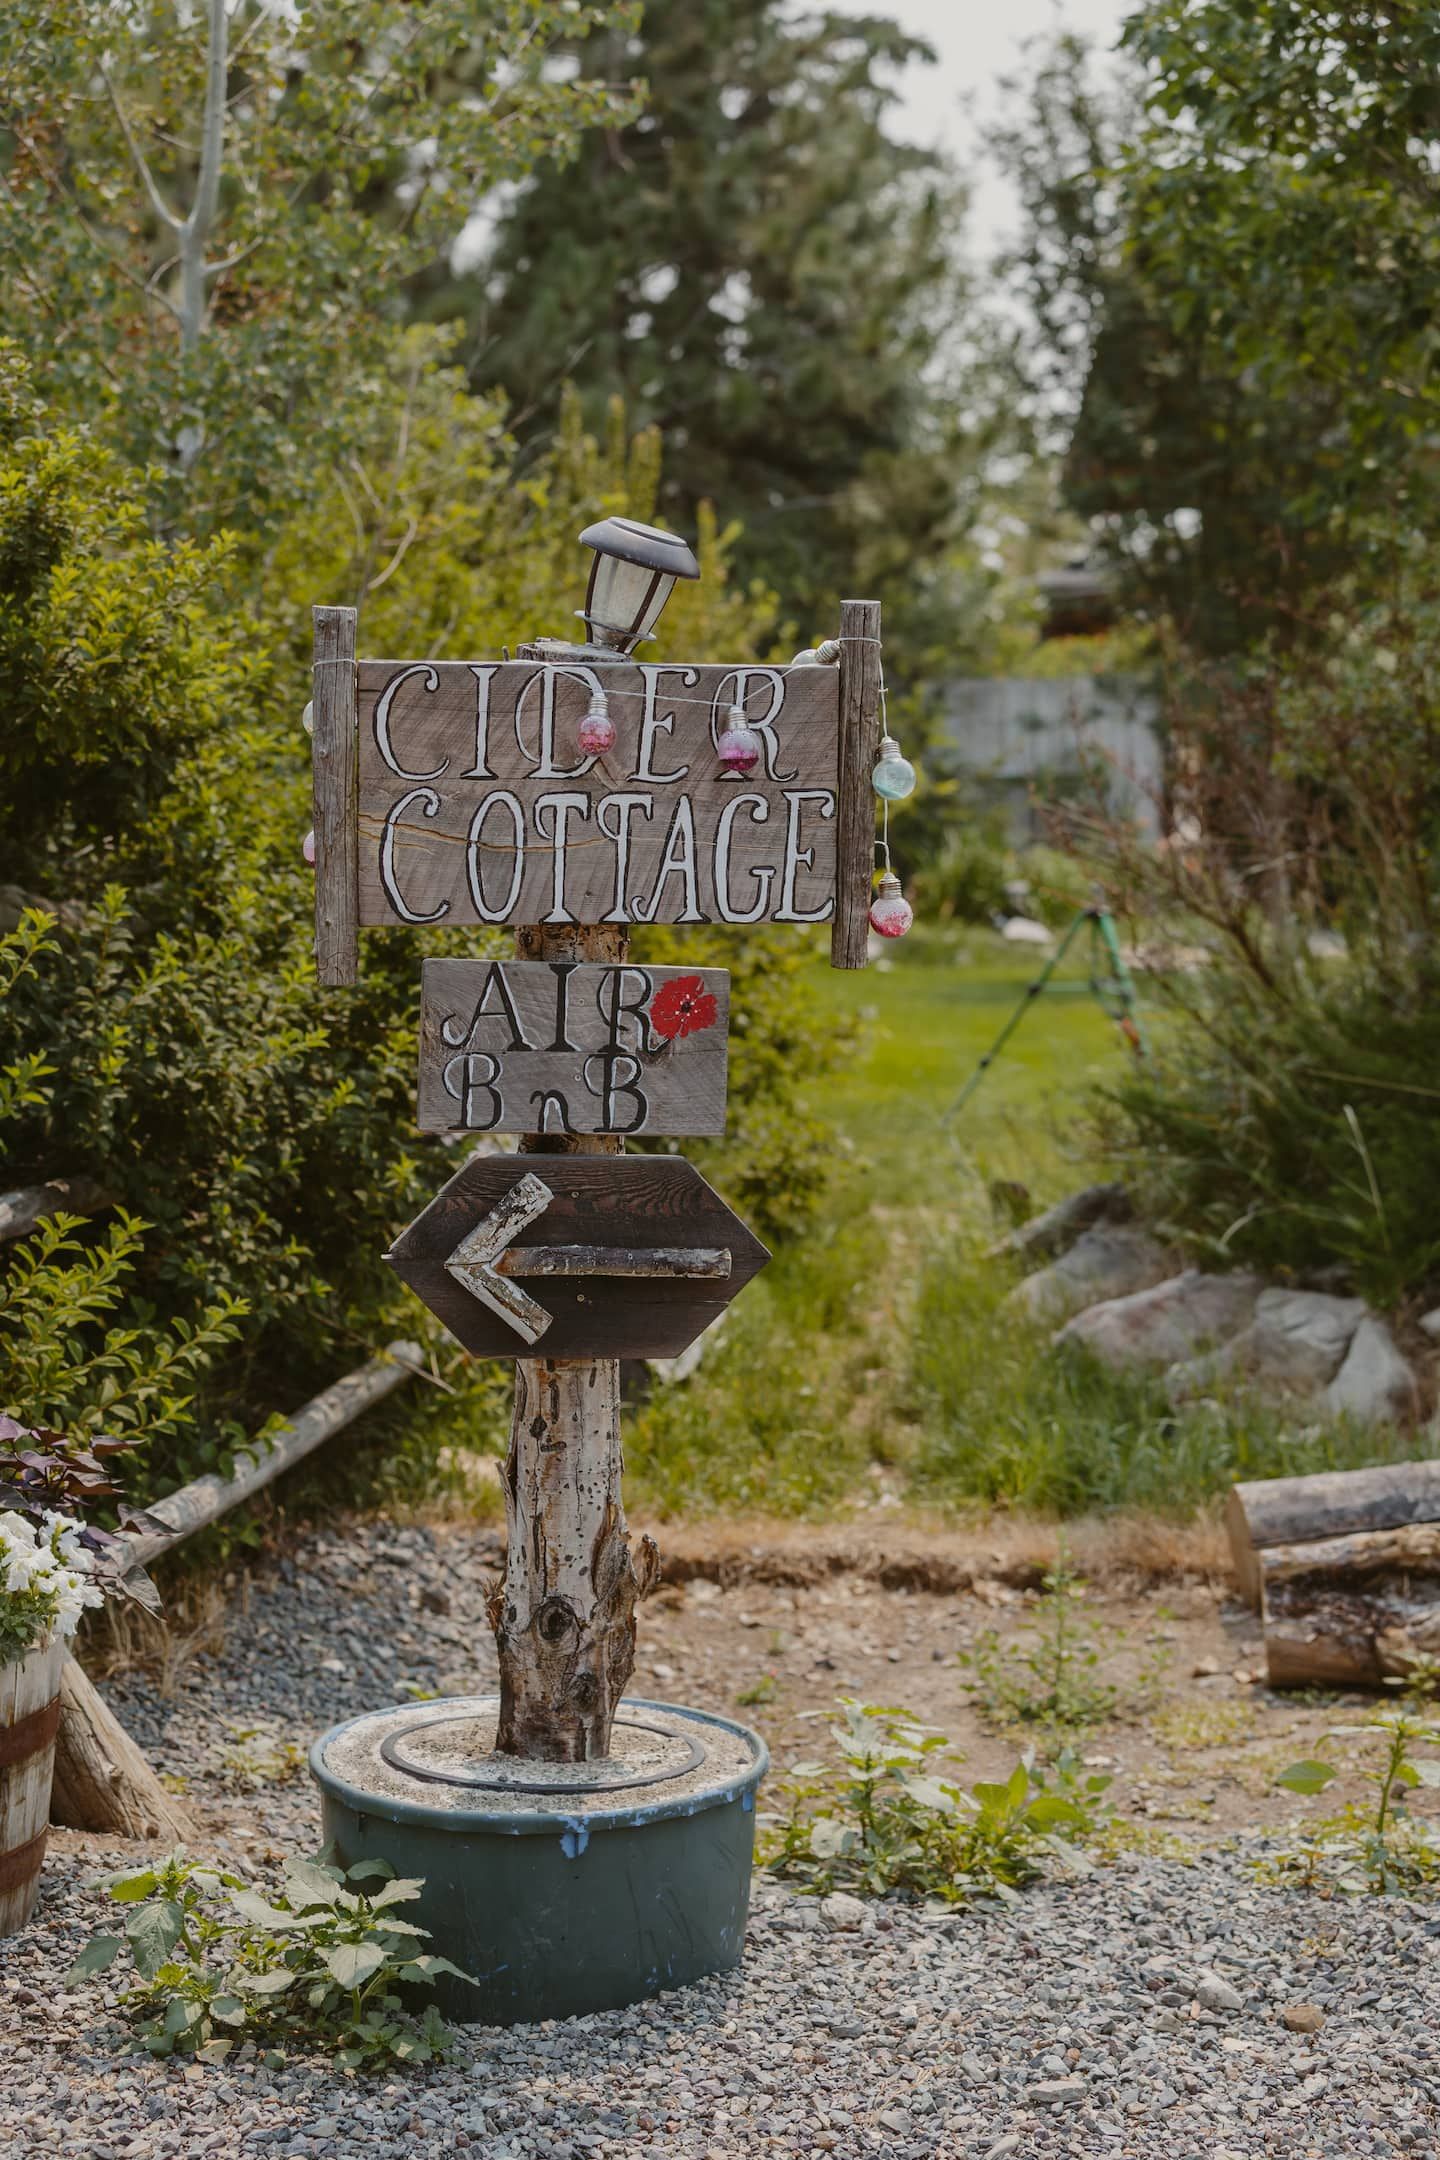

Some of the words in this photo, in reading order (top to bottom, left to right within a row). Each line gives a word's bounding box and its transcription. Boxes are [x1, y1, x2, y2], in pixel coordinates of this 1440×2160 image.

[374, 664, 798, 782] CIDER
[379, 787, 836, 924] COTTAGE
[440, 961, 671, 1053] AIR
[442, 1052, 649, 1133] BnB
